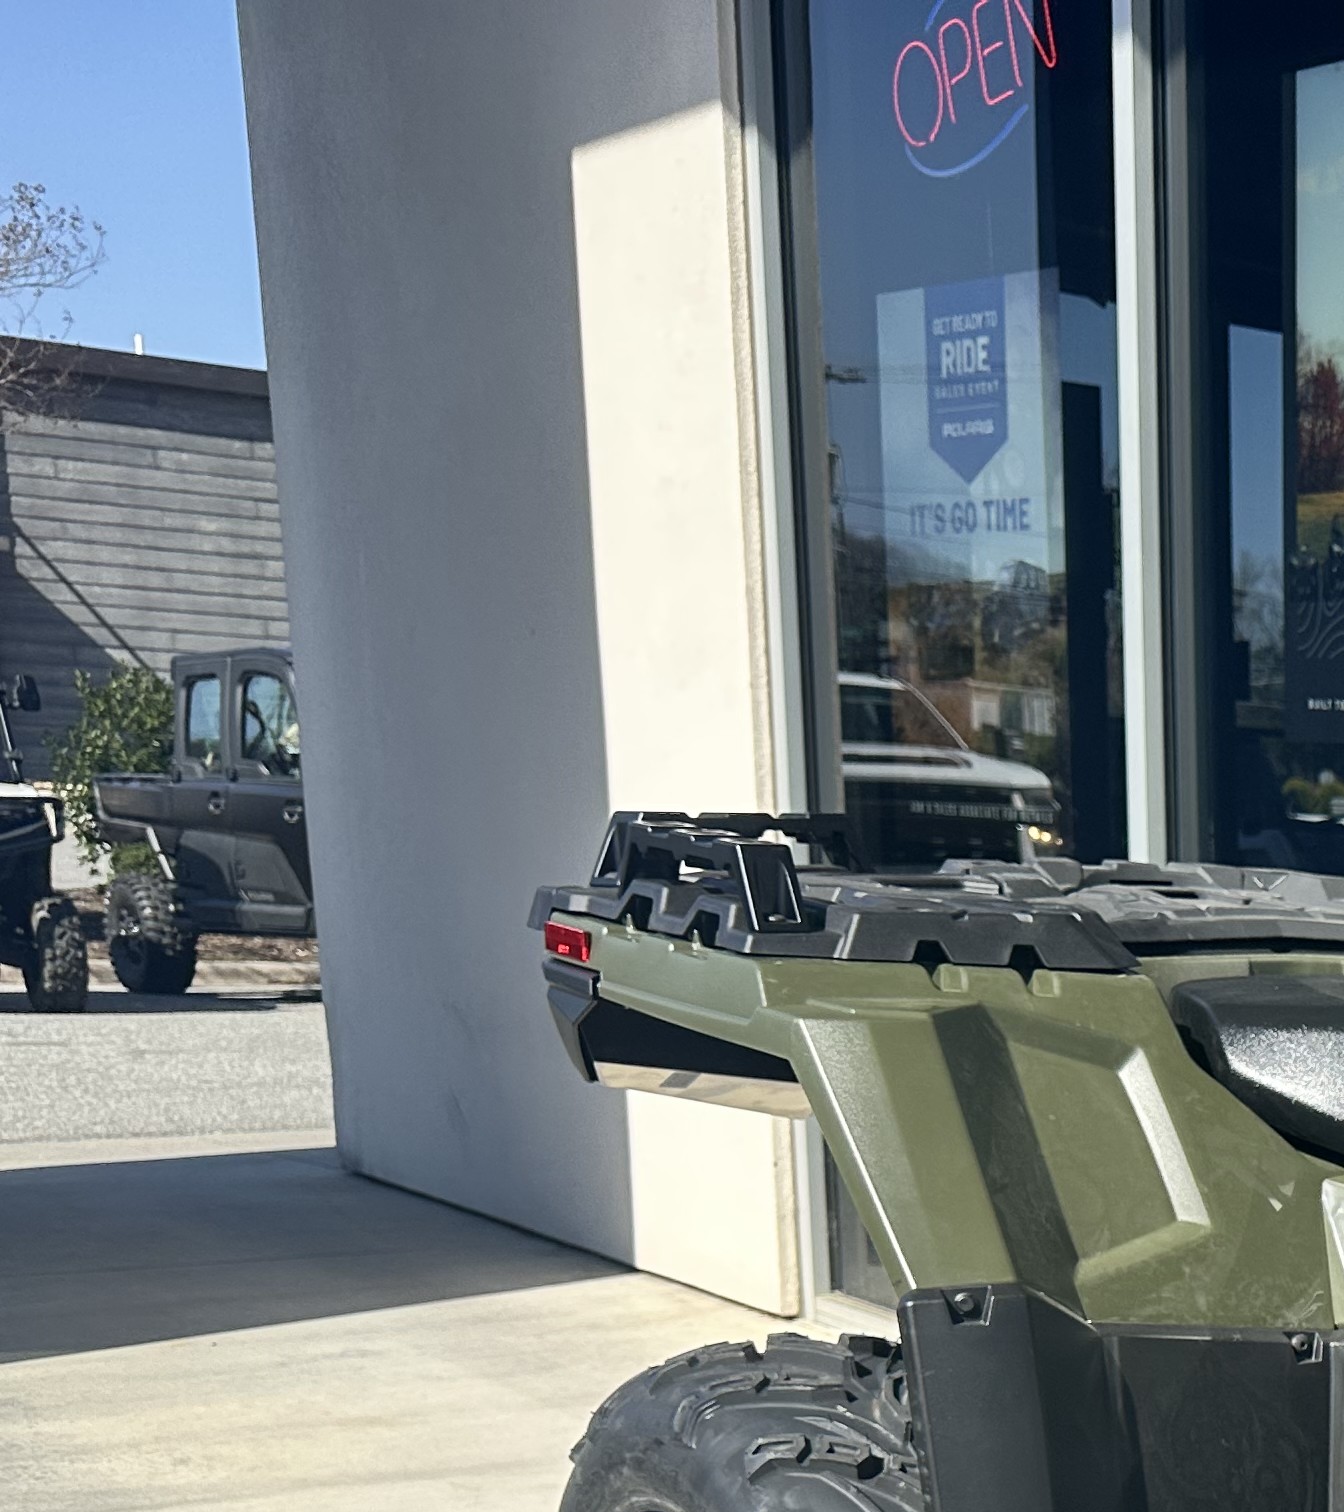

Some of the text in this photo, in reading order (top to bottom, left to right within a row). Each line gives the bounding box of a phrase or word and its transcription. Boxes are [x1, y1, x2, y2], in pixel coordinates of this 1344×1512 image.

[893, 0, 1057, 147] OPEN
[940, 335, 991, 378] RIDE
[909, 497, 1031, 538] IT'S GO TIME
